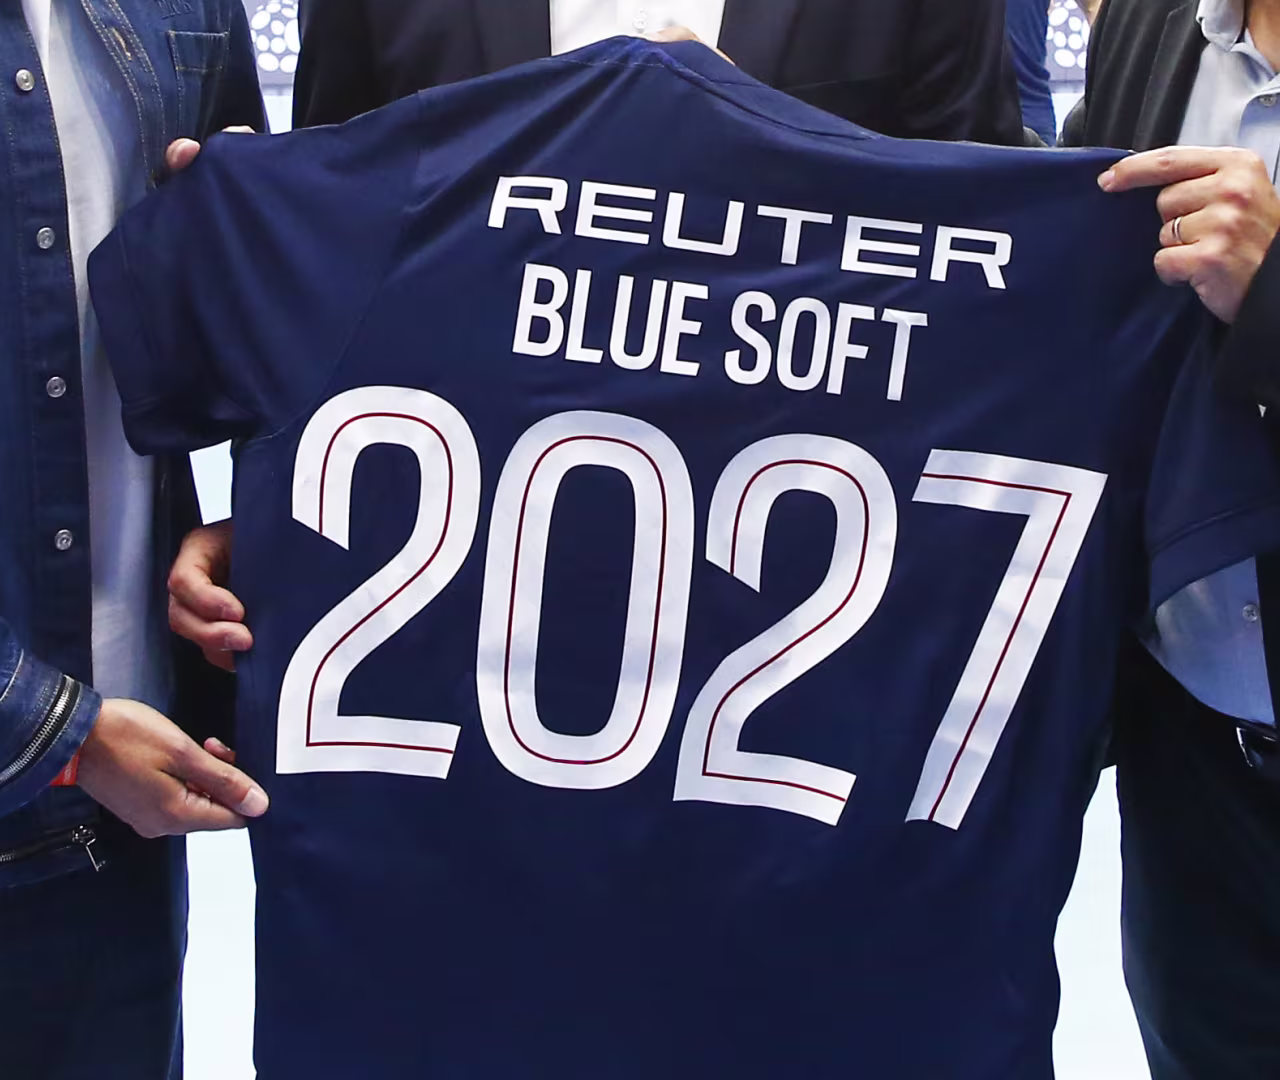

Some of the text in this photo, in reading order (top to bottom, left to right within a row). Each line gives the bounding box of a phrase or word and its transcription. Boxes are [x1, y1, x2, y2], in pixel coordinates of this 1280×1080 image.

[487, 175, 1014, 290] REUTER
[511, 263, 928, 402] BLUE SOFT
[275, 384, 1108, 831] 2027
